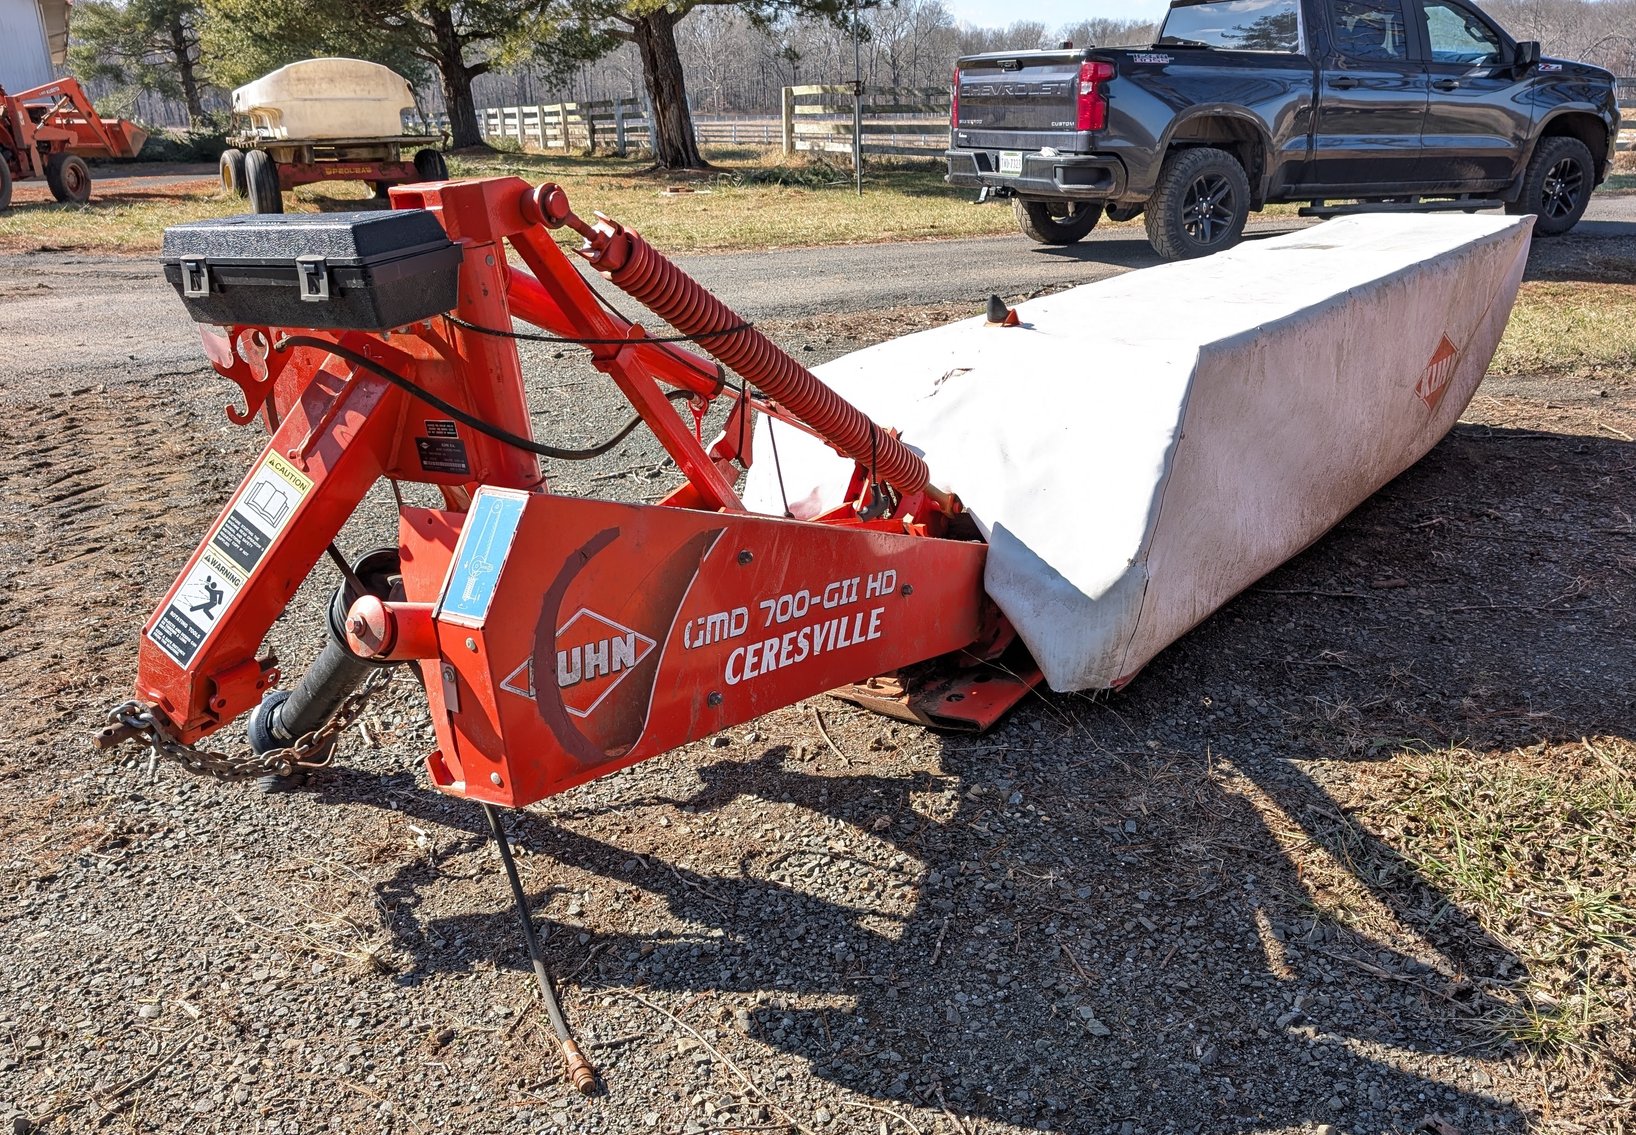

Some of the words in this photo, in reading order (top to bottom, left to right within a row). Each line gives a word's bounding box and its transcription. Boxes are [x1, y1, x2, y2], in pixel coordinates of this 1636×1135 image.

[961, 83, 1070, 96] CHEVROLET
[274, 462, 307, 490] CAUTION
[211, 558, 241, 586] WARNING
[759, 576, 861, 628] 700-GII
[865, 569, 898, 599] HD
[188, 627, 201, 639] TOOLS
[724, 606, 886, 686] CERESVILLE
[528, 632, 637, 697] UHN
